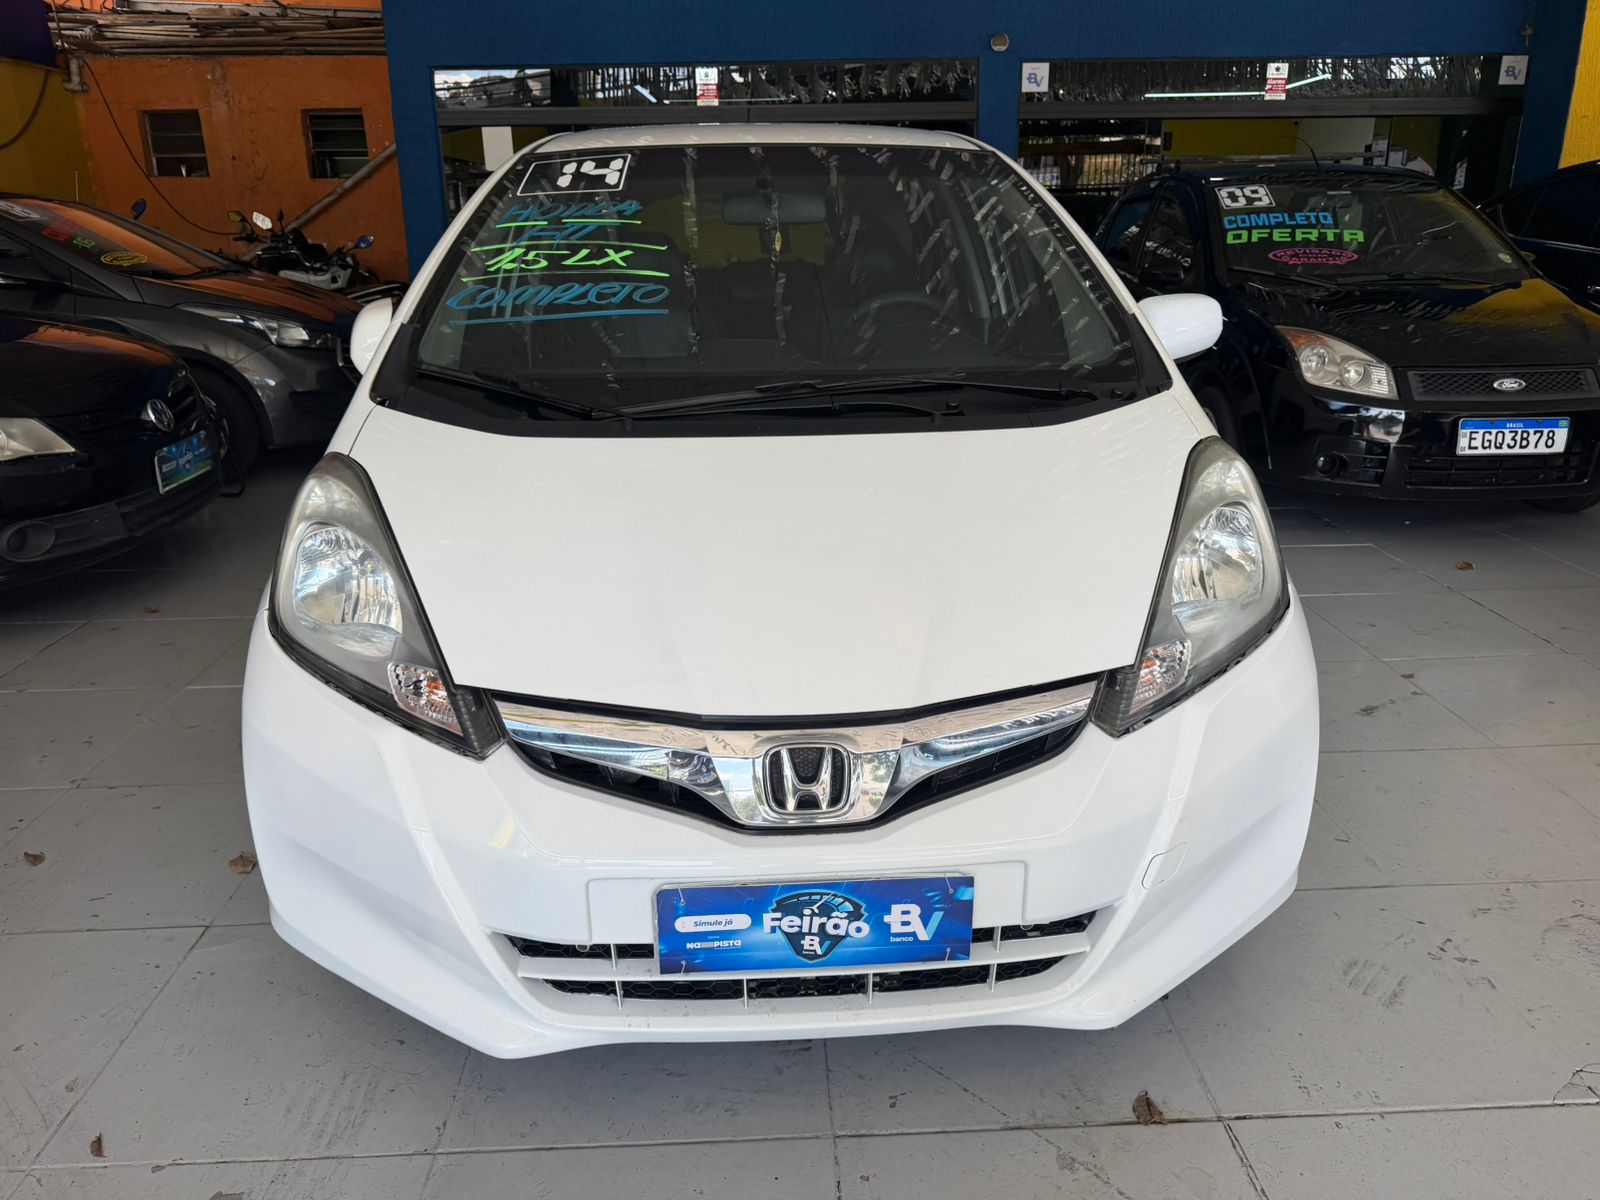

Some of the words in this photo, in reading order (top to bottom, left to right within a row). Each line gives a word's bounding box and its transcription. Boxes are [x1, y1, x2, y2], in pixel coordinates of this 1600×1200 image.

[1219, 185, 1271, 207] 09
[1223, 212, 1334, 229] COMPLETO
[1226, 229, 1365, 244] OFERTA
[561, 249, 634, 267] LX
[1467, 430, 1555, 450] EGQ3B78
[693, 919, 723, 928] Simule
[723, 918, 733, 928] já
[763, 909, 870, 938] Feirão
[884, 903, 945, 941] BV
[801, 935, 831, 955] BV
